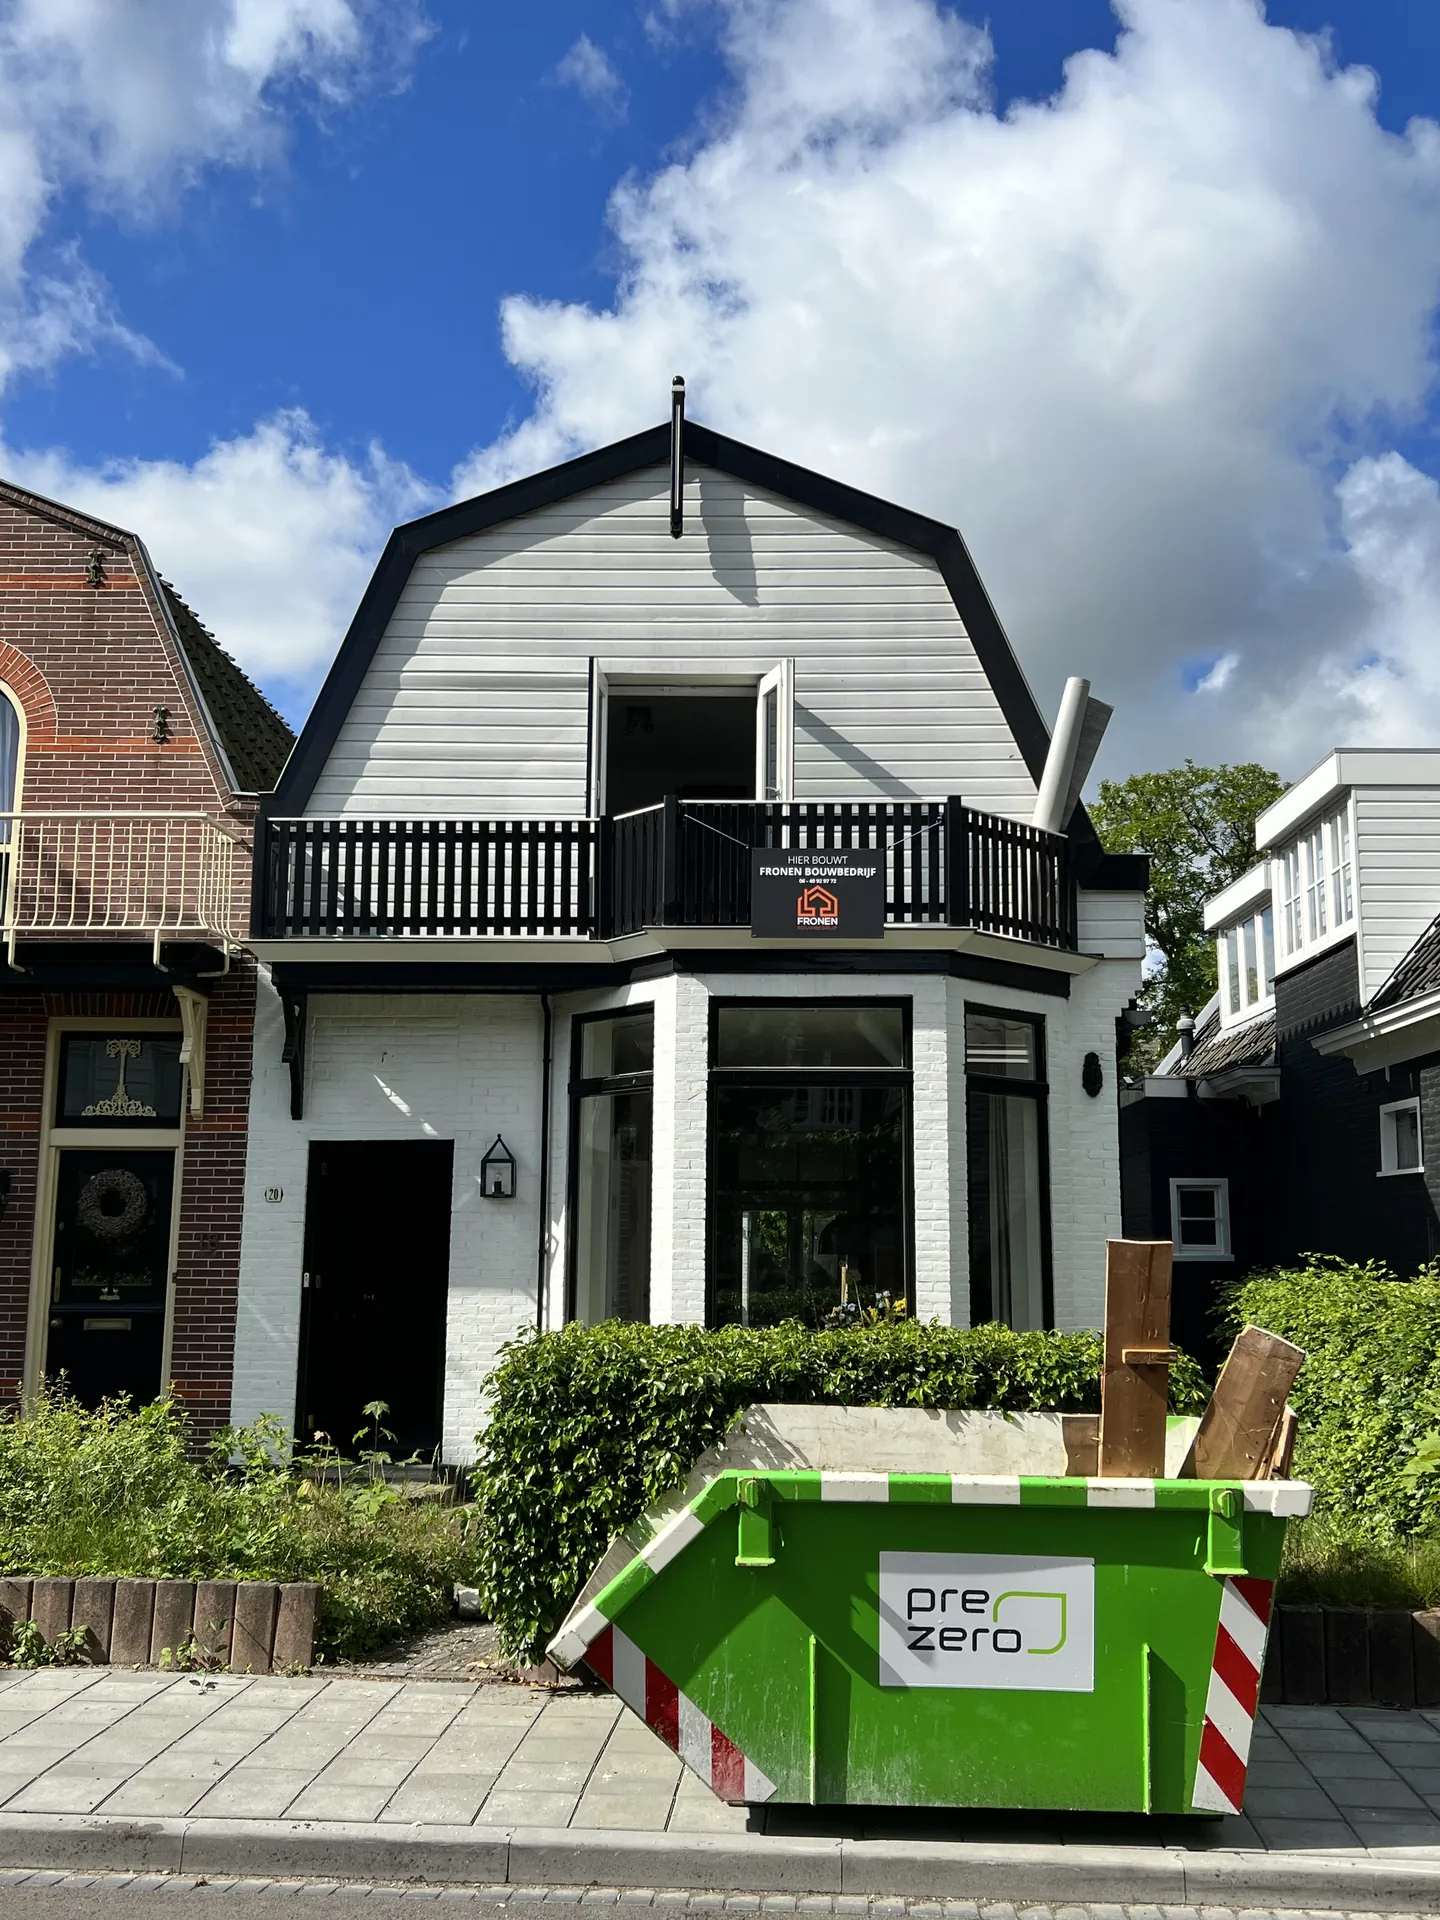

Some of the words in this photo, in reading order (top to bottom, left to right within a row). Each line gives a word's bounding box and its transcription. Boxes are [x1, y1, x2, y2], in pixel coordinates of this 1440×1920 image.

[788, 856, 810, 864] HIER
[812, 856, 848, 864] BOUWT
[760, 867, 802, 876] FRONEN
[805, 867, 877, 878] BOUWBEDRIJF
[797, 917, 838, 926] FRONEN
[269, 1189, 279, 1200] 20
[907, 1588, 990, 1620] pre
[907, 1626, 1022, 1653] zero
